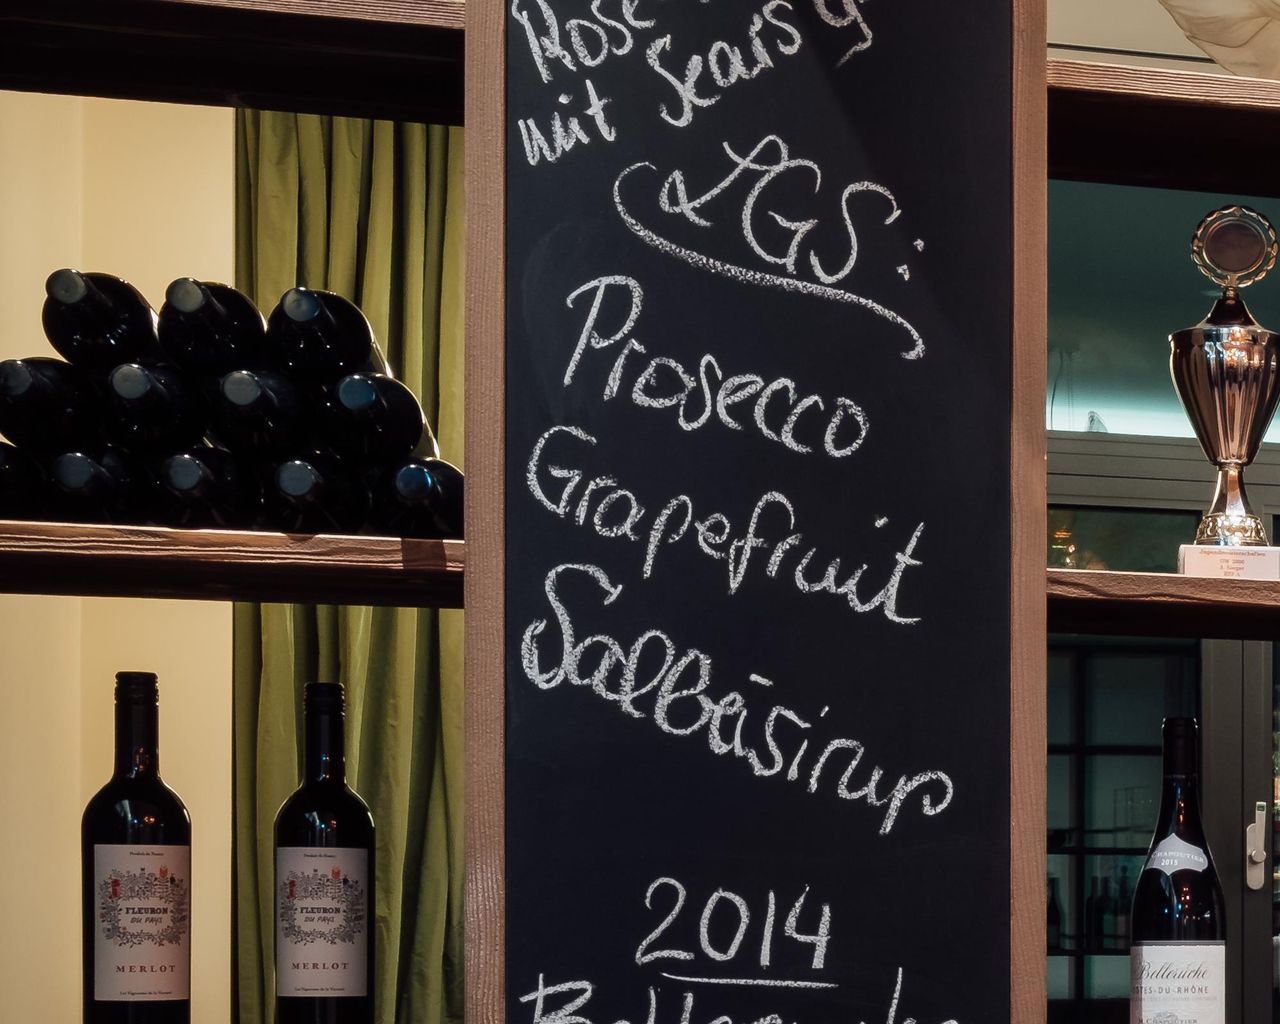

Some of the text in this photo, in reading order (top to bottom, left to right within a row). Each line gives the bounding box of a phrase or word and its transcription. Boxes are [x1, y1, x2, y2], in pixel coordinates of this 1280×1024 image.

[564, 275, 870, 458] Prosecco
[526, 425, 925, 625] Grapefruit
[126, 906, 170, 915] FLEURON
[299, 906, 341, 914] FLEURON
[635, 877, 832, 970] 2014
[116, 964, 177, 973] MERLOT
[291, 962, 350, 970] MERLOT
